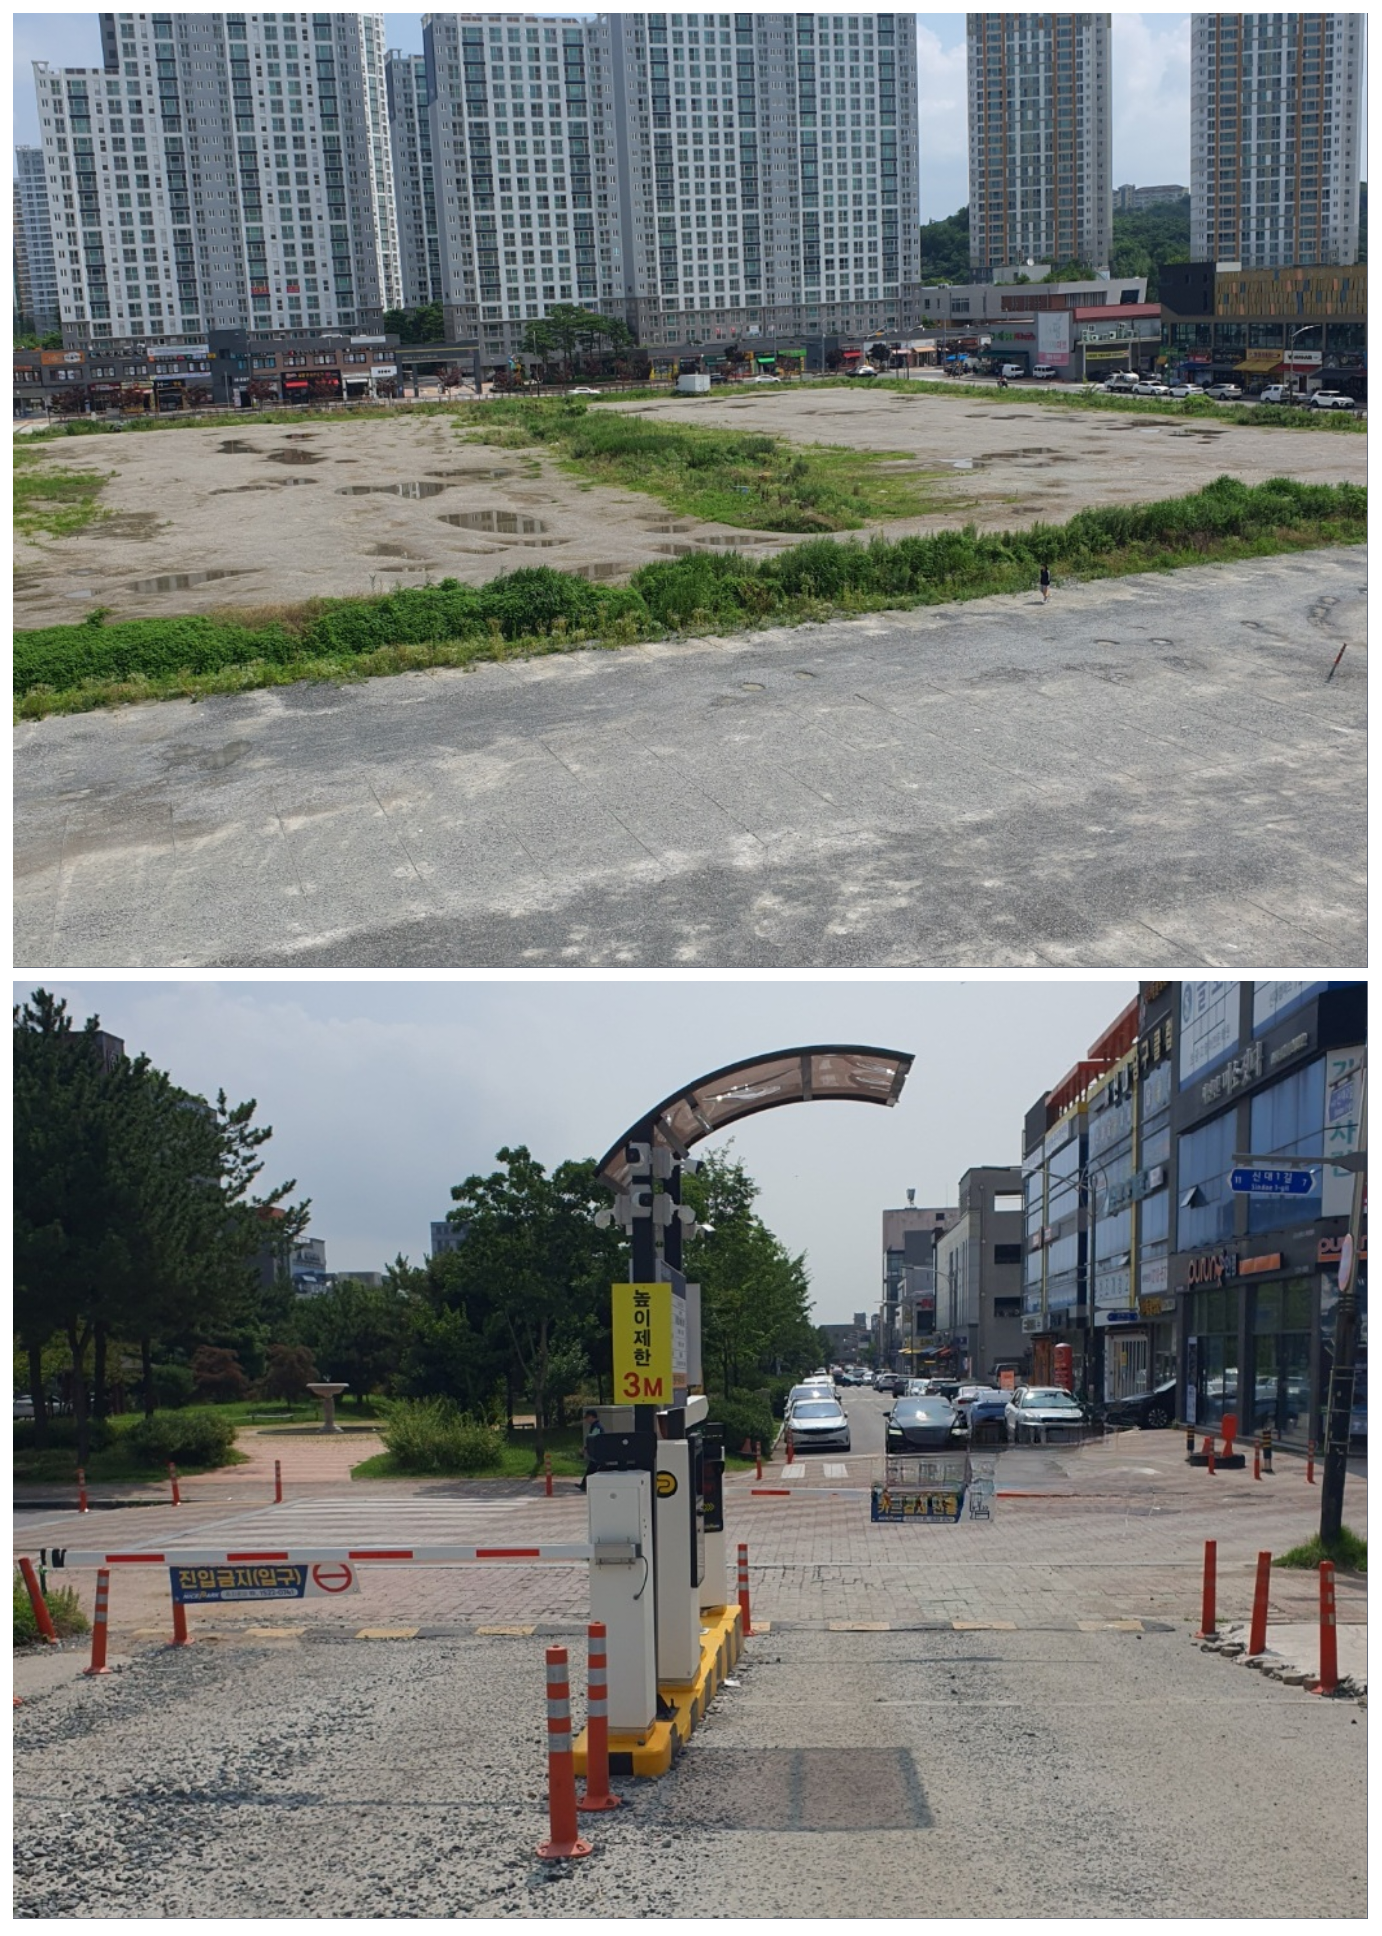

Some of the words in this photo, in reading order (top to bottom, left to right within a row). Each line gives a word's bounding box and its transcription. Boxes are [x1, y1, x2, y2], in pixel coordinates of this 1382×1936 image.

[1252, 1171, 1293, 1184] 신대1길
[633, 1289, 652, 1367] 높이제한
[623, 1372, 663, 1398] 3M
[179, 1568, 301, 1589] 진입금지(입구)
